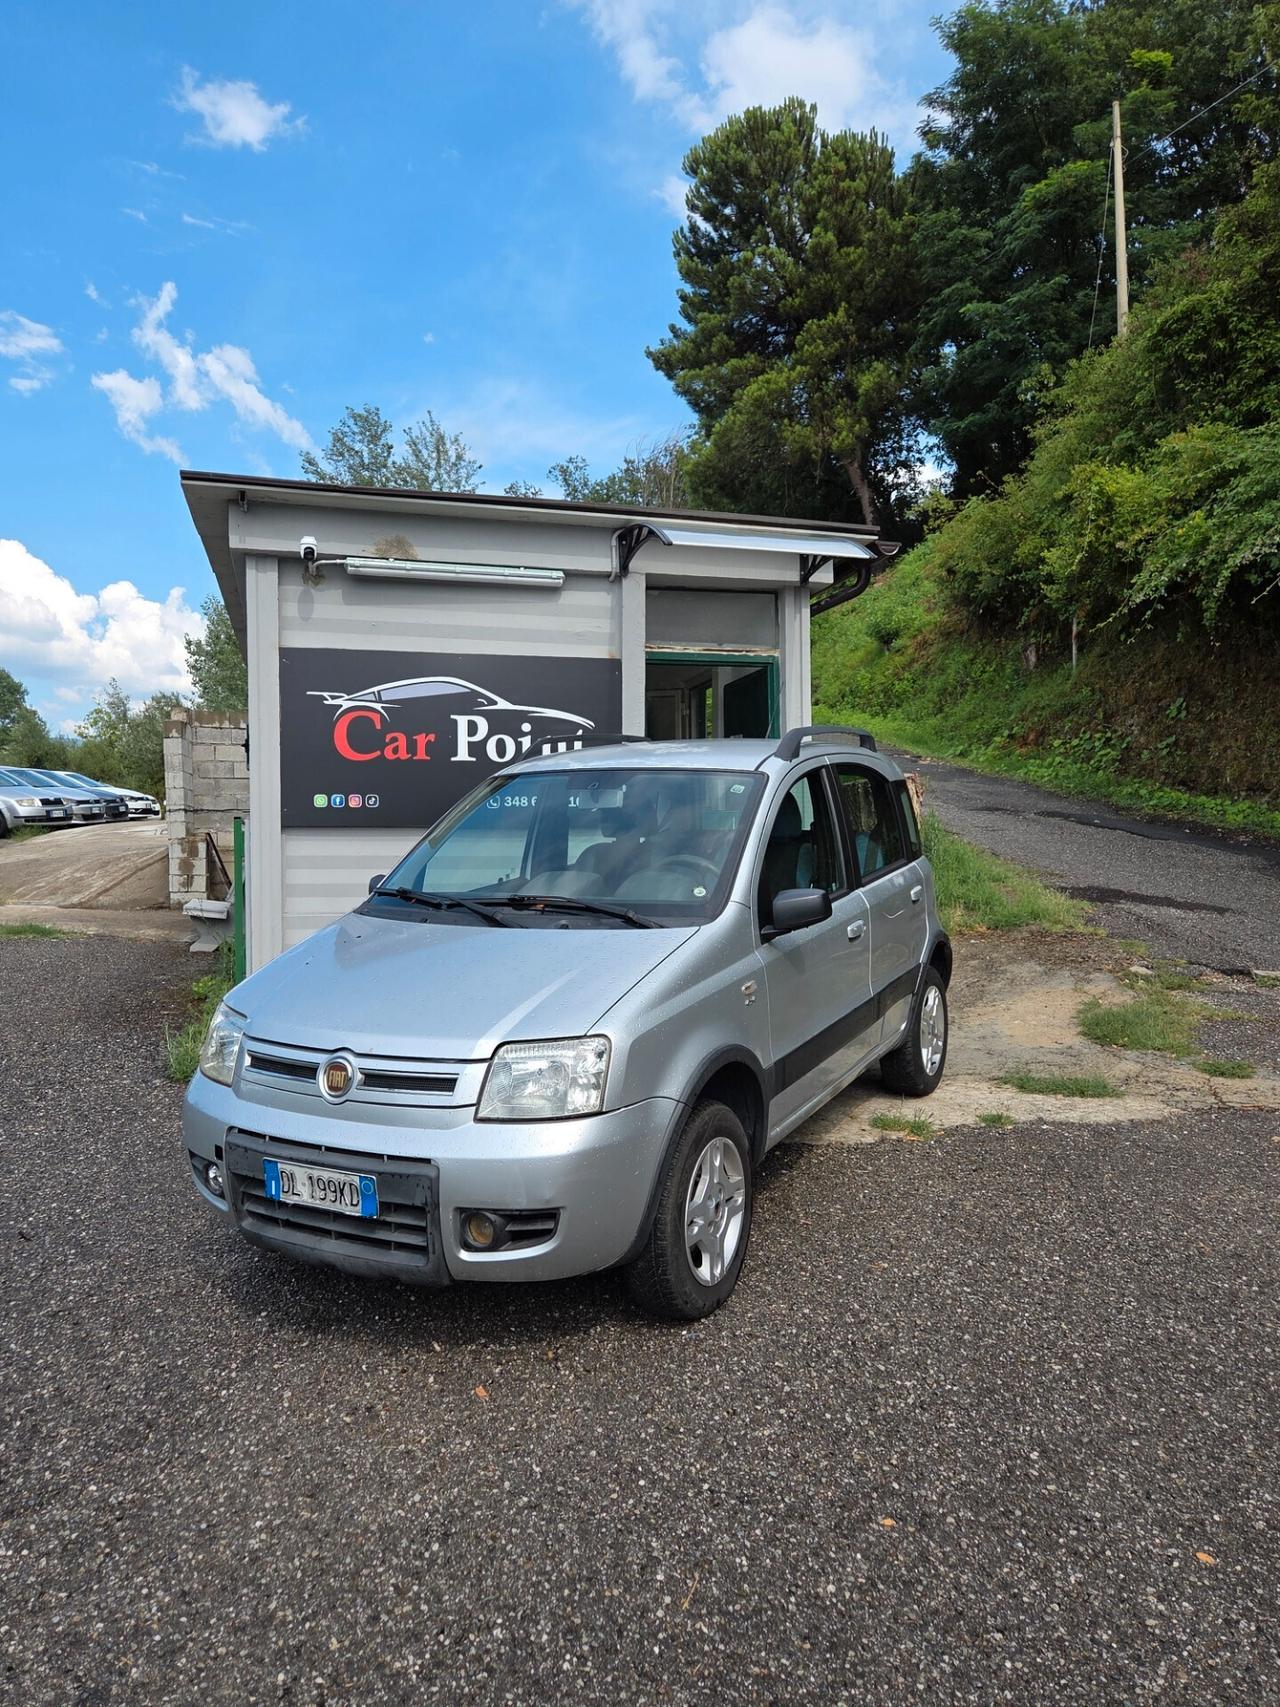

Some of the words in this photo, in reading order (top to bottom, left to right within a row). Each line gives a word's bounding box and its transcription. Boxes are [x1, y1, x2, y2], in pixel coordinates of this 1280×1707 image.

[333, 710, 436, 761] Car
[504, 795, 528, 807] 348
[328, 1070, 346, 1088] FIAT
[280, 1170, 301, 1196] DL
[308, 1175, 360, 1207] 199KD
